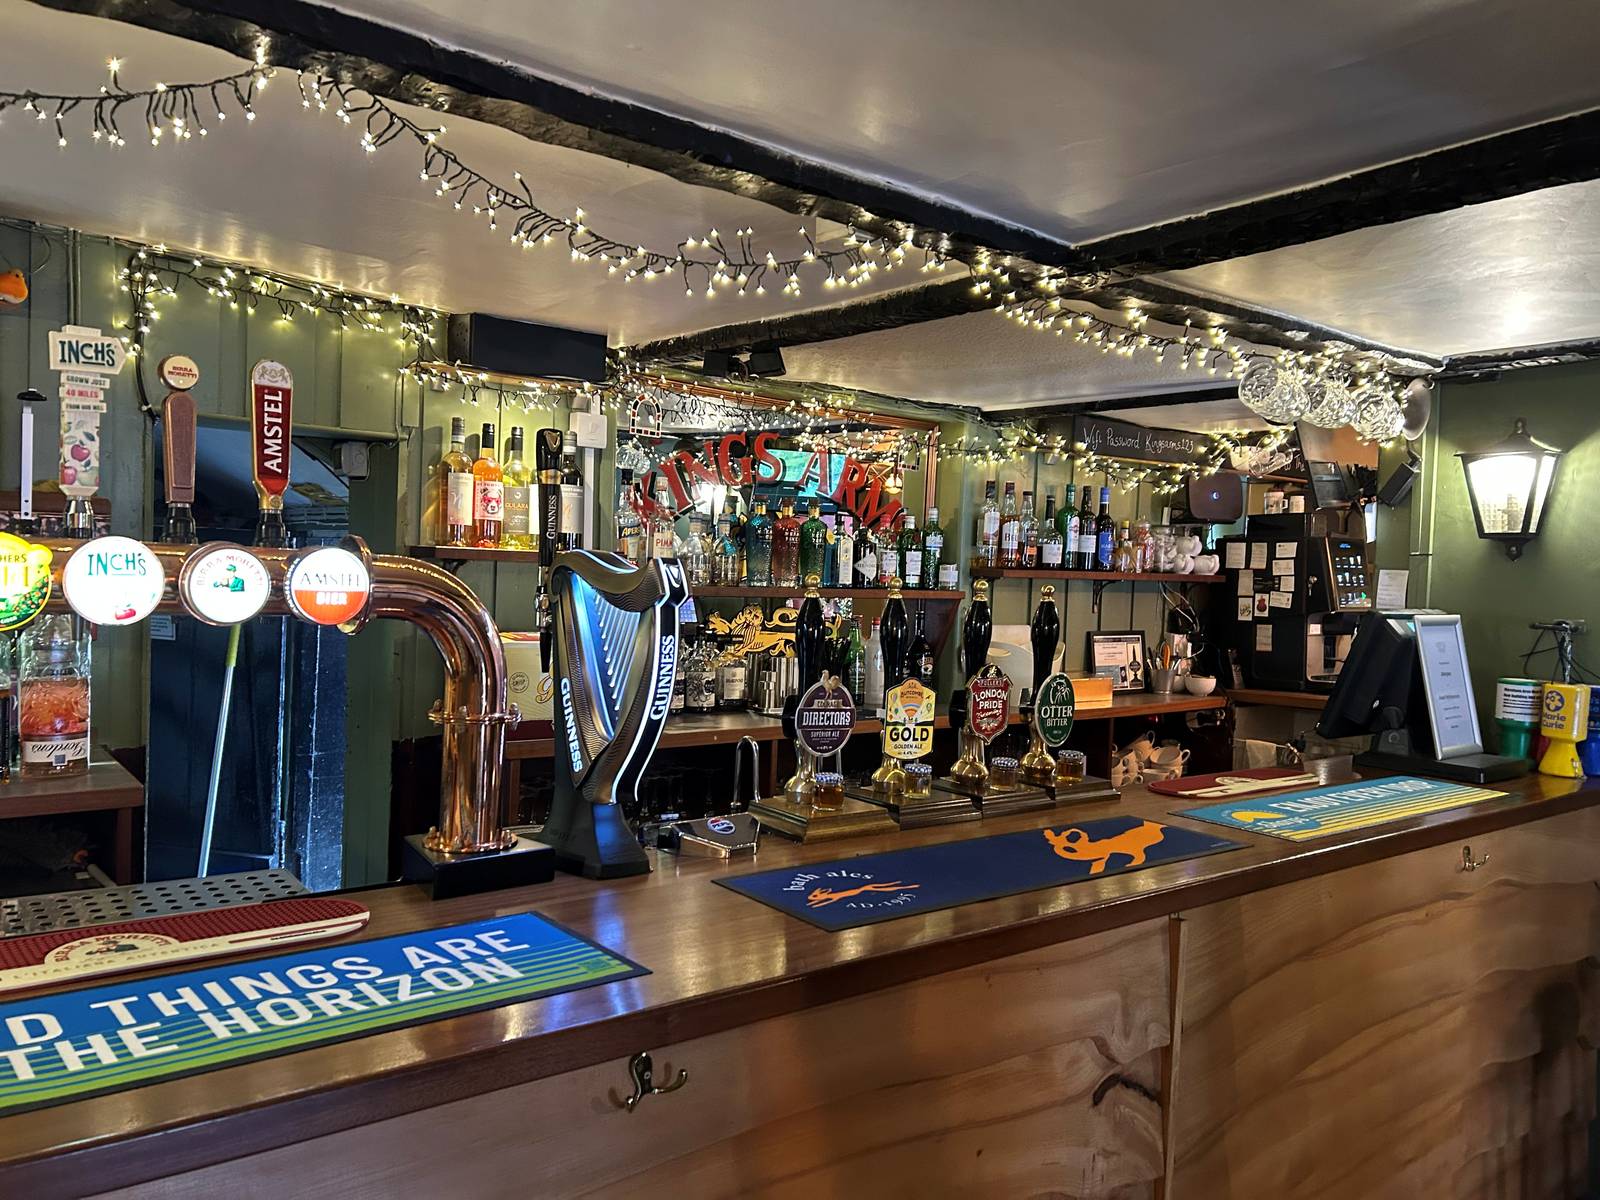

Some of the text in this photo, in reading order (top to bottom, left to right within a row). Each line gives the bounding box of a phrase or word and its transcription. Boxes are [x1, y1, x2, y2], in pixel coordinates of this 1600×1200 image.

[263, 391, 283, 474] AMSTEL
[1107, 427, 1140, 449] Password
[546, 494, 558, 540] GUINNESS
[301, 572, 361, 587] AMSTEL
[650, 635, 676, 720] GUINNESS
[975, 688, 1008, 702] LONDON
[979, 700, 1003, 710] PRIDE
[802, 711, 852, 726] DIRECTORS
[1041, 705, 1073, 718] OTTER
[561, 677, 583, 772] GUINNESS
[1046, 718, 1068, 727] BITTER
[889, 726, 930, 742] GOLD
[782, 870, 874, 891] bath ales
[55, 934, 172, 962] BIRRA MORETTI
[89, 957, 384, 1026] THINGS
[402, 930, 530, 969] ARE
[0, 957, 526, 1080] THE HORIZON
